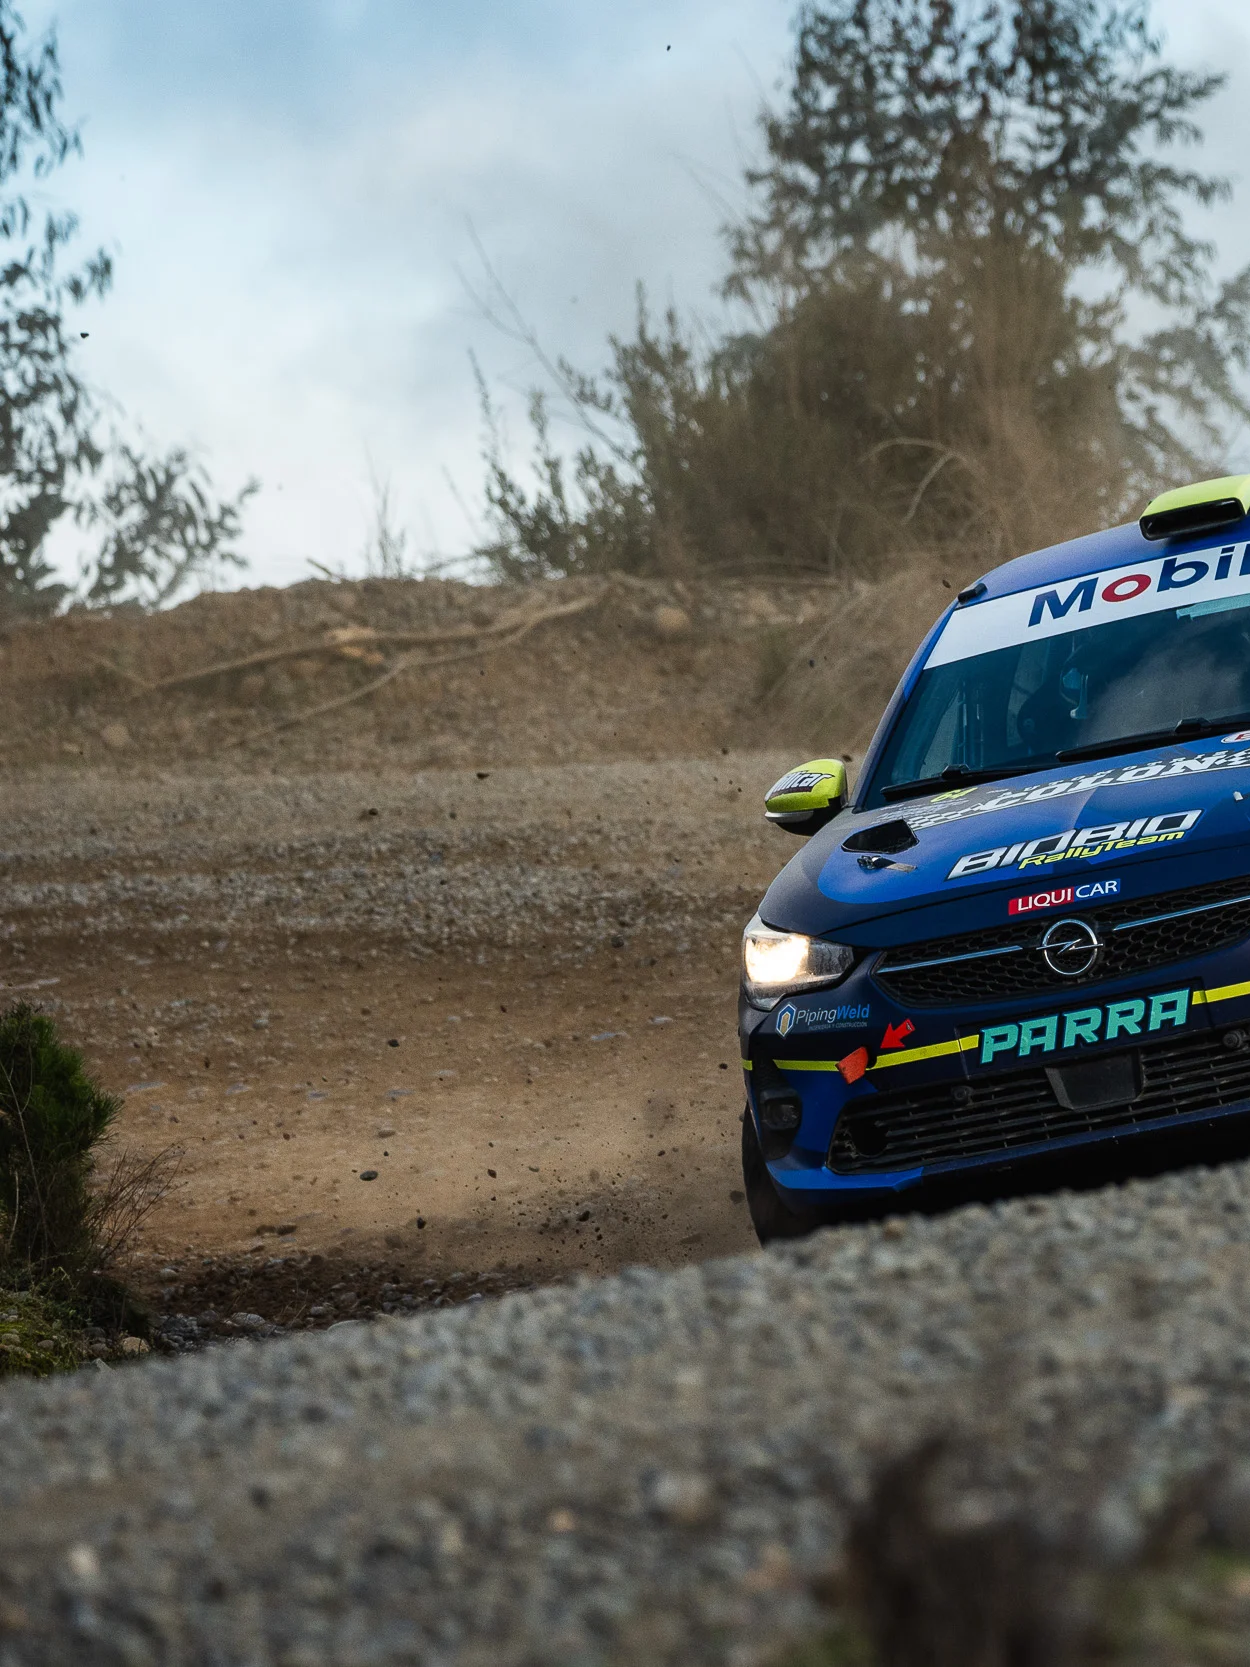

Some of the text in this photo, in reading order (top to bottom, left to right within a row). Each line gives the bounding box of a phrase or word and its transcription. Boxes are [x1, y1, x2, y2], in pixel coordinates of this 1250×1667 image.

[984, 754, 1224, 812] COLON
[947, 809, 1202, 881] BIOBIO
[1018, 831, 1185, 870] RallyTeam
[796, 1003, 870, 1026] PipingWeld
[981, 988, 1190, 1064] PARRA
